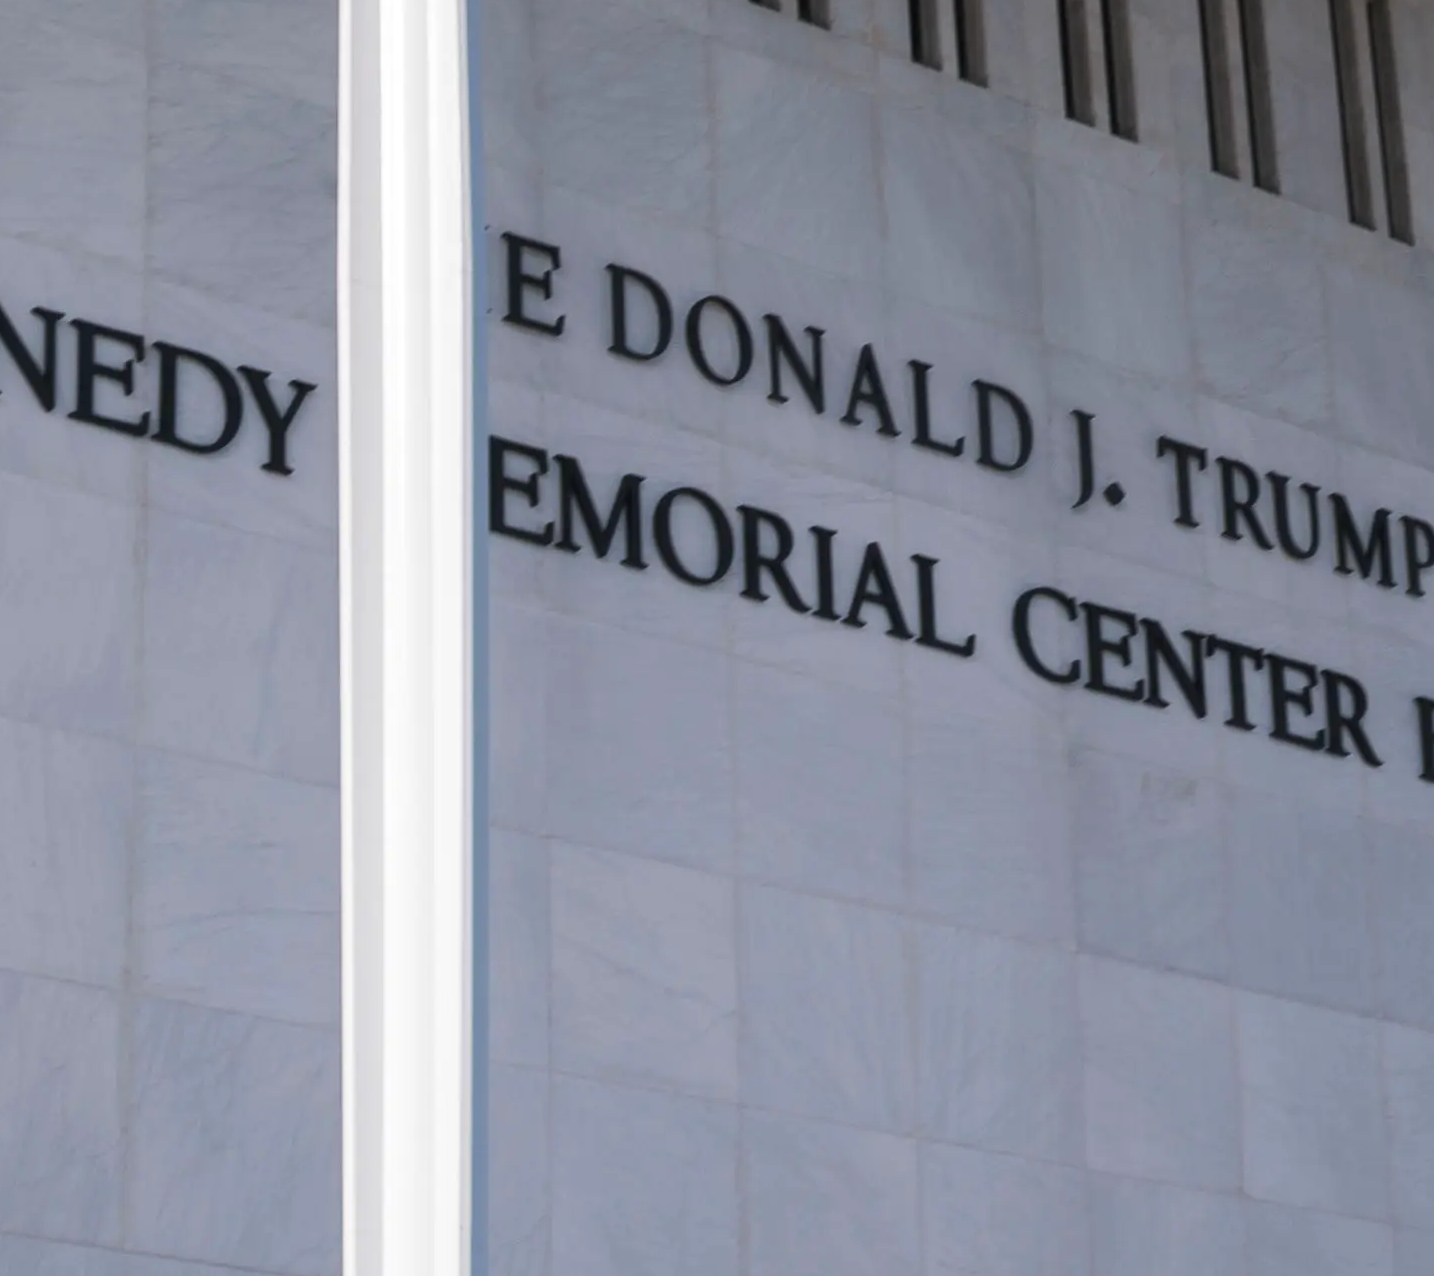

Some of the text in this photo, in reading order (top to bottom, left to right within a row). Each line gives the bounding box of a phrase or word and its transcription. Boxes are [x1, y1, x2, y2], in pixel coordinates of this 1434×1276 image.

[605, 262, 1034, 474] DONALD
[1070, 409, 1126, 510] J.
[488, 434, 976, 659] EMORIAL
[1011, 585, 1384, 769] CENTER
